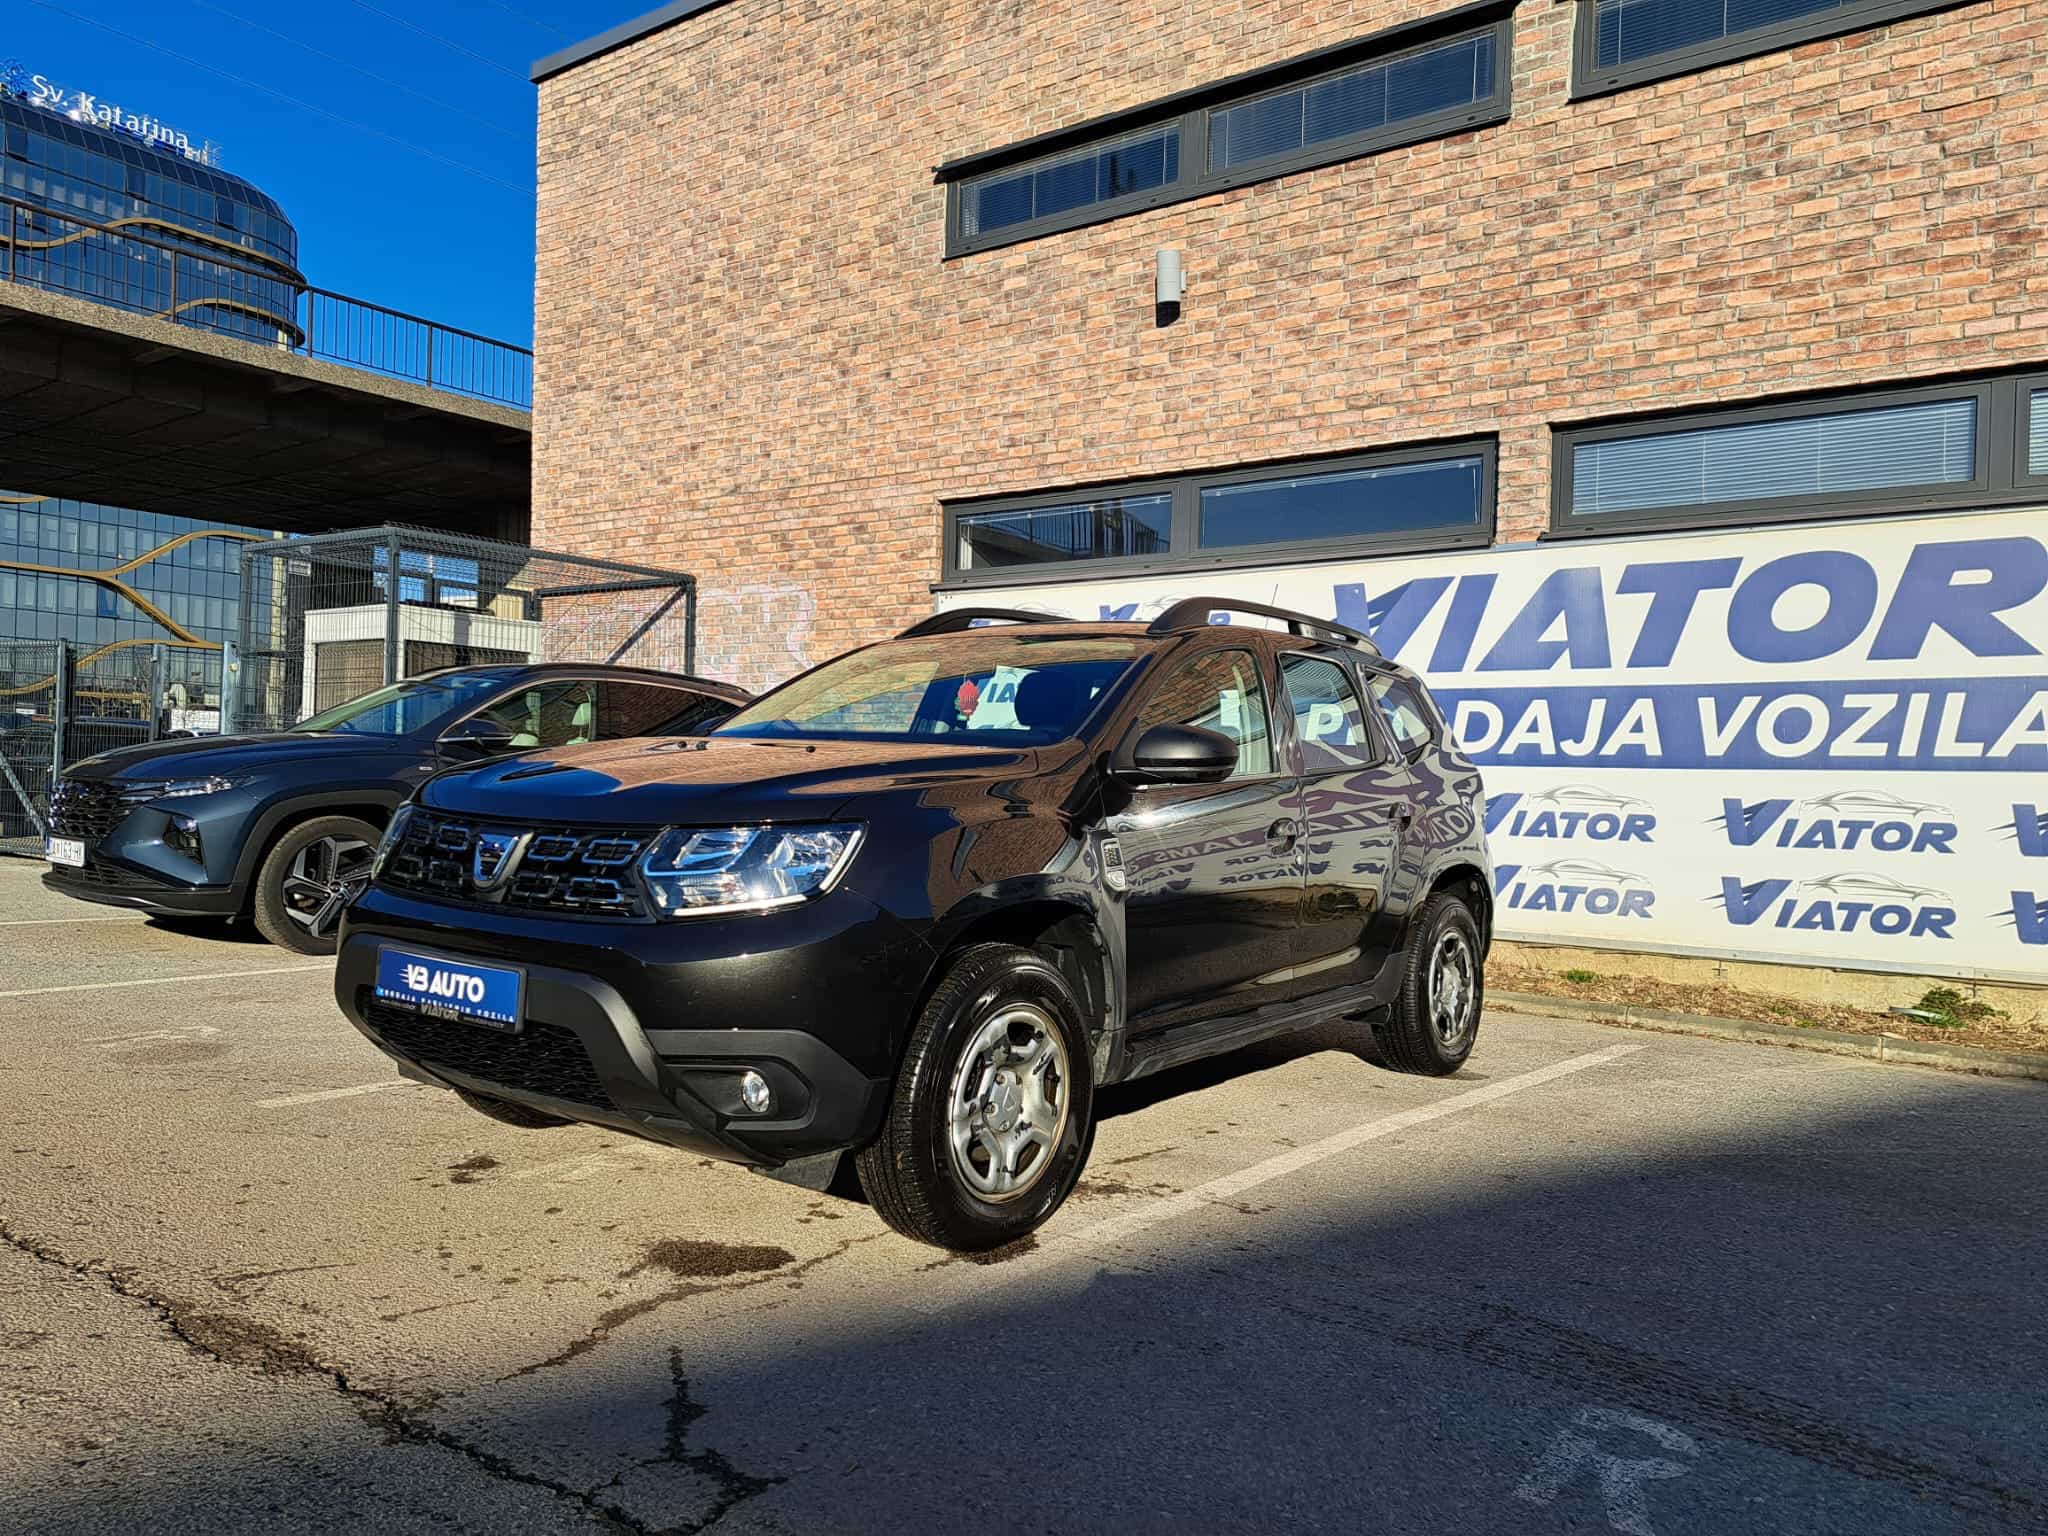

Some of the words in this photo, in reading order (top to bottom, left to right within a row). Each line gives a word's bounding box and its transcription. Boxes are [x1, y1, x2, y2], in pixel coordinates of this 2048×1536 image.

[31, 74, 68, 106] Sv.
[80, 91, 188, 149] Katarina
[1330, 536, 2048, 673] VIATOR
[1697, 690, 2048, 758] VOZILA
[1722, 798, 1958, 854] VIATOR
[1721, 876, 1957, 939] VIATOR
[429, 970, 485, 1003] AUTO
